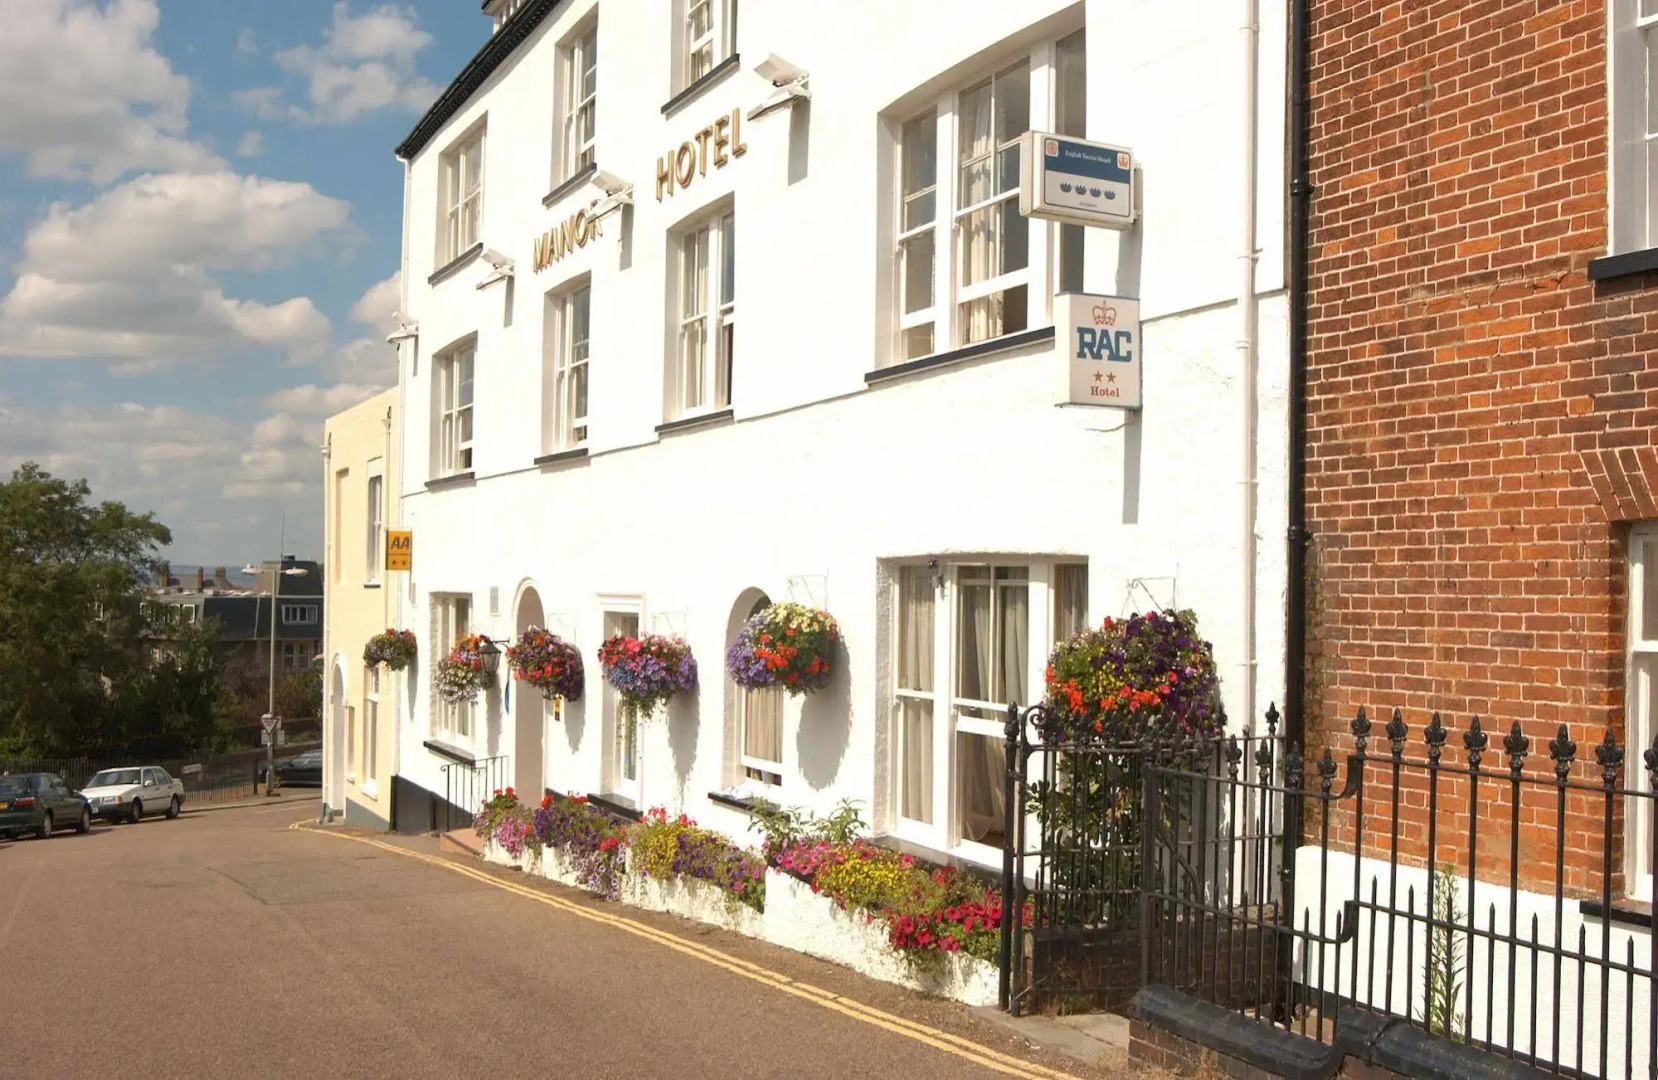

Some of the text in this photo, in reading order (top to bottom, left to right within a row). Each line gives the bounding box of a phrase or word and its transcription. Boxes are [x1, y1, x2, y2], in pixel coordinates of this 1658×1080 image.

[655, 107, 748, 204] HOTEL
[1076, 326, 1132, 363] RAC
[1090, 386, 1120, 398] Hotel
[390, 536, 410, 550] AA
